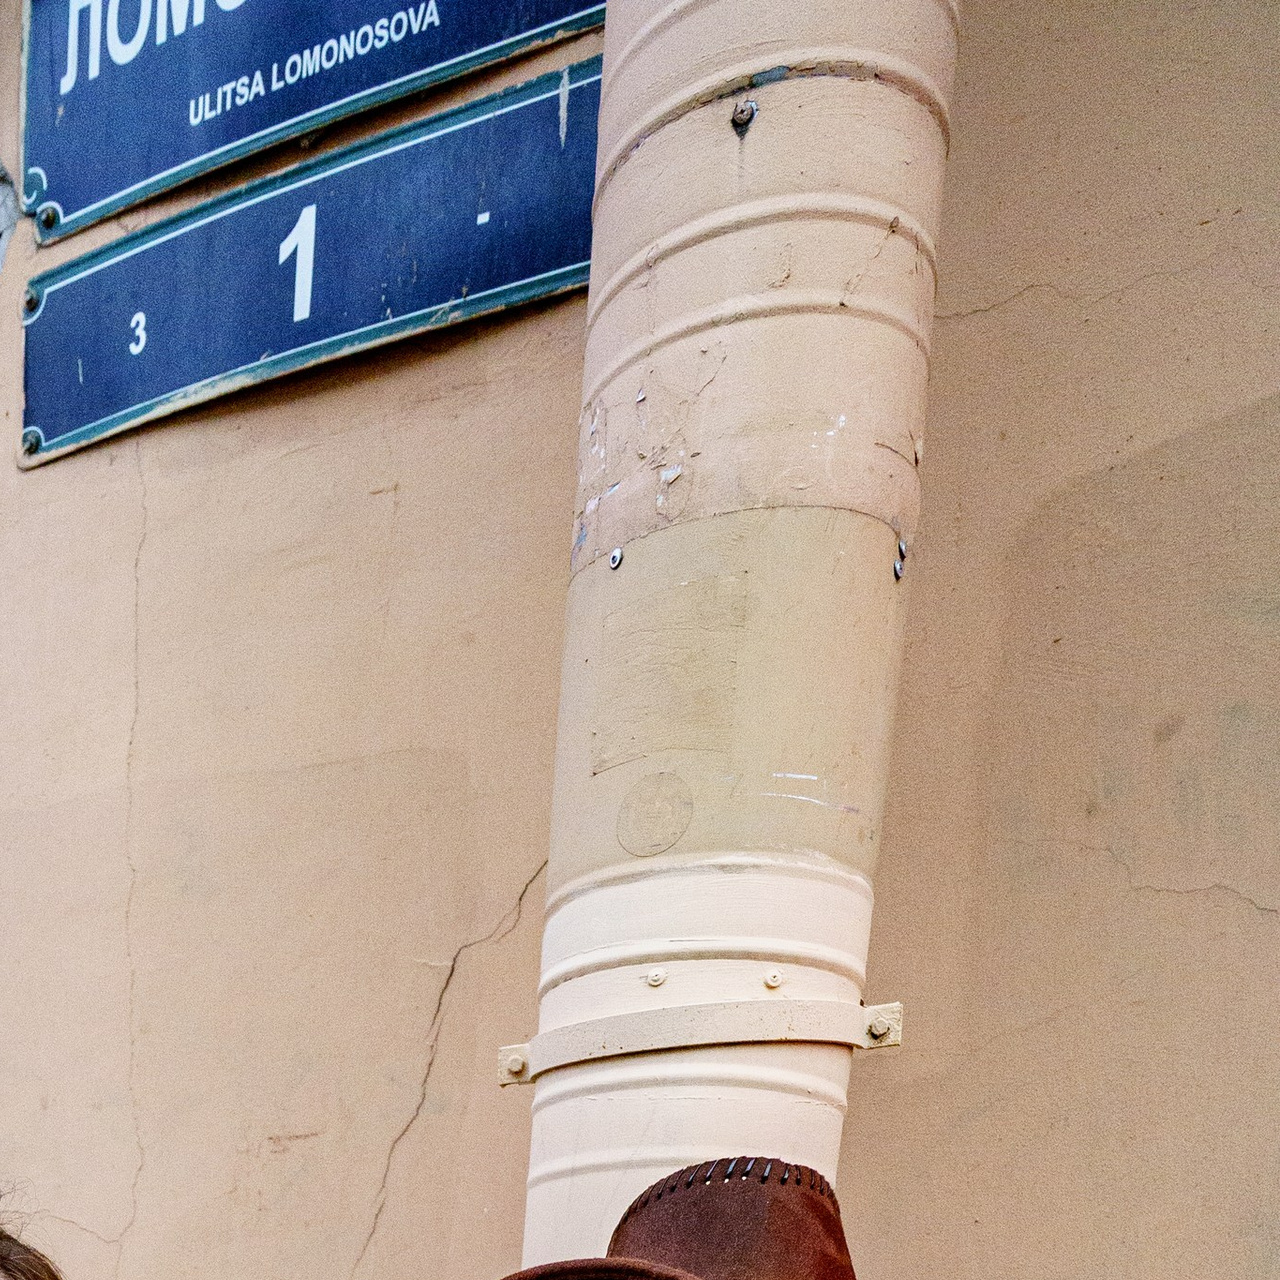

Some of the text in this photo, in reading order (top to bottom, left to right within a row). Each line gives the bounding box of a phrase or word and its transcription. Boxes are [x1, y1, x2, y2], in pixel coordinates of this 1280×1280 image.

[60, 0, 248, 95] ЛО
[189, 0, 441, 127] ULITSA LOMONOSOVA
[128, 311, 147, 356] 3
[278, 203, 317, 323] 1
